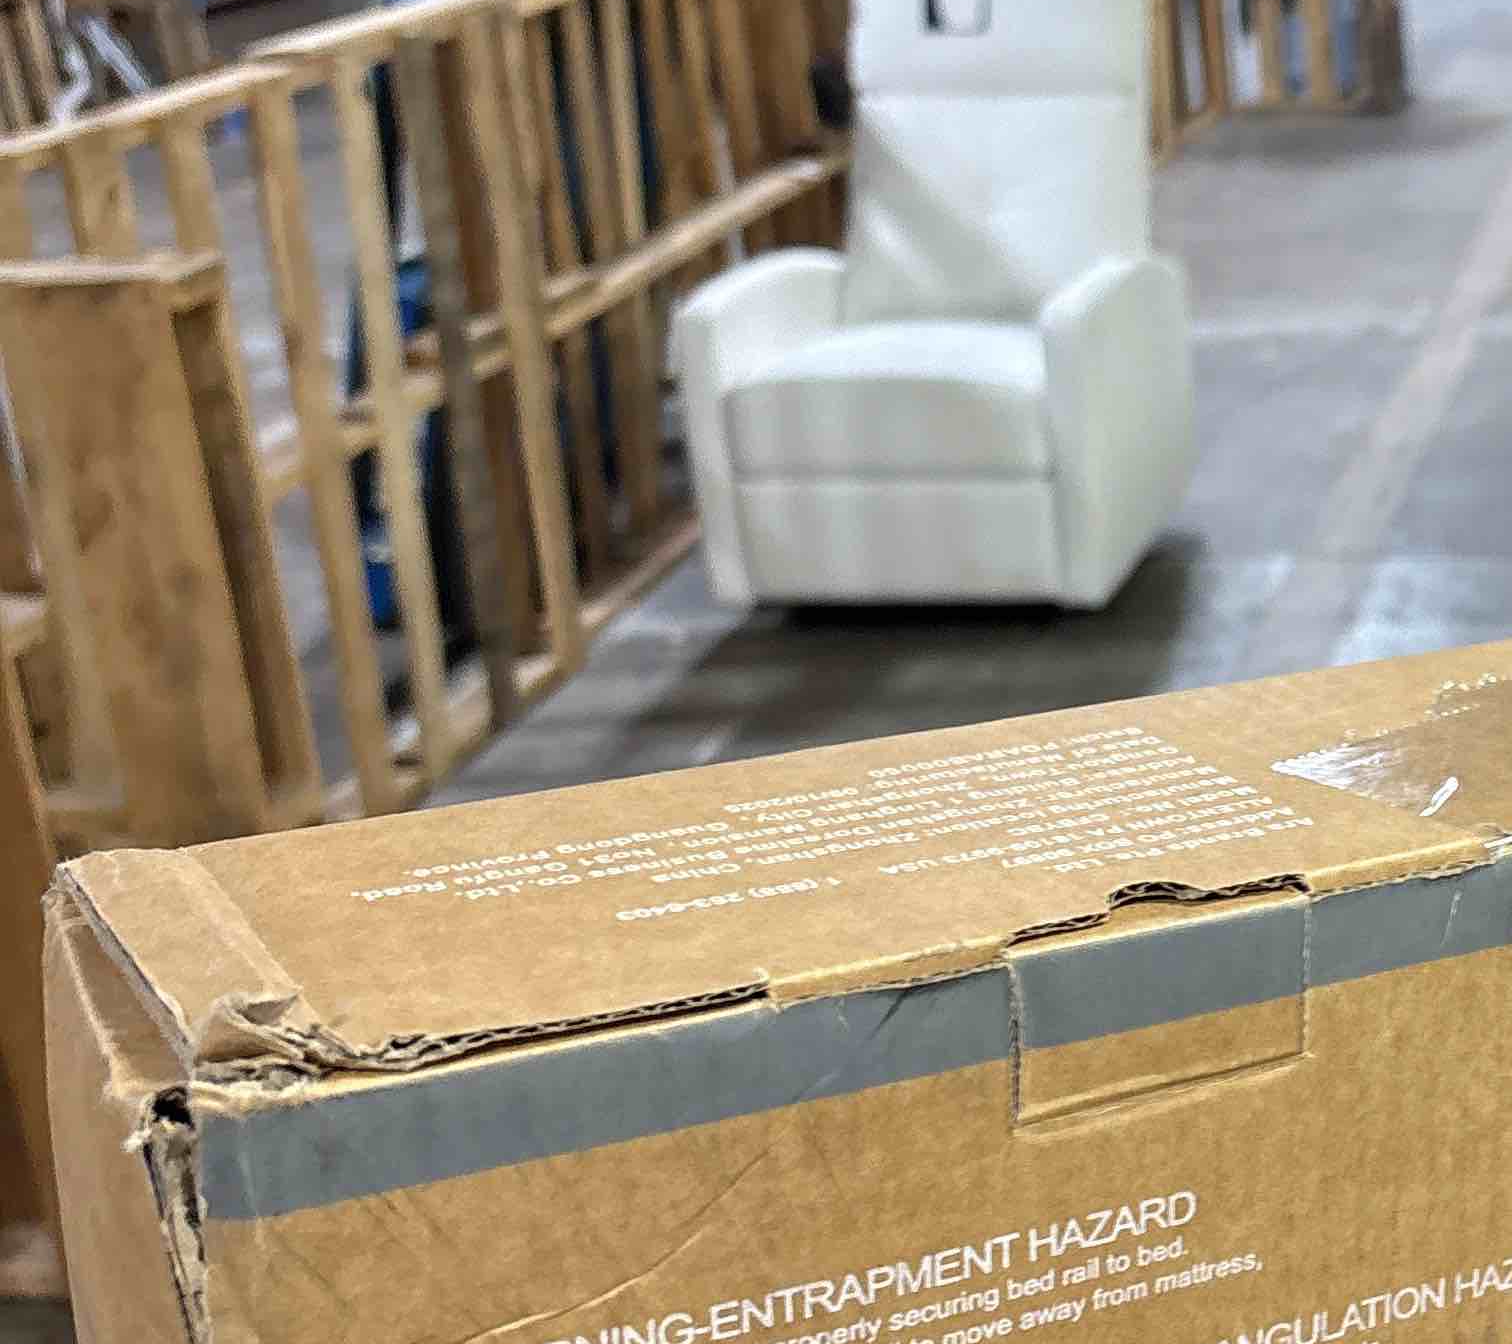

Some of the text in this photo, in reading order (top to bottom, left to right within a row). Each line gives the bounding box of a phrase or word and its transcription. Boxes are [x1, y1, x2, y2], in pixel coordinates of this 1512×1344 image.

[1026, 1188, 1198, 1263] HAZARD
[887, 1286, 1001, 1332] securing
[1005, 1266, 1056, 1301] bed
[1060, 1255, 1100, 1287] rail
[1103, 1252, 1132, 1275] to
[1135, 1234, 1189, 1267] bed.
[1017, 1296, 1087, 1331] away
[1090, 1280, 1150, 1311] from
[1152, 1251, 1264, 1294] mattress,
